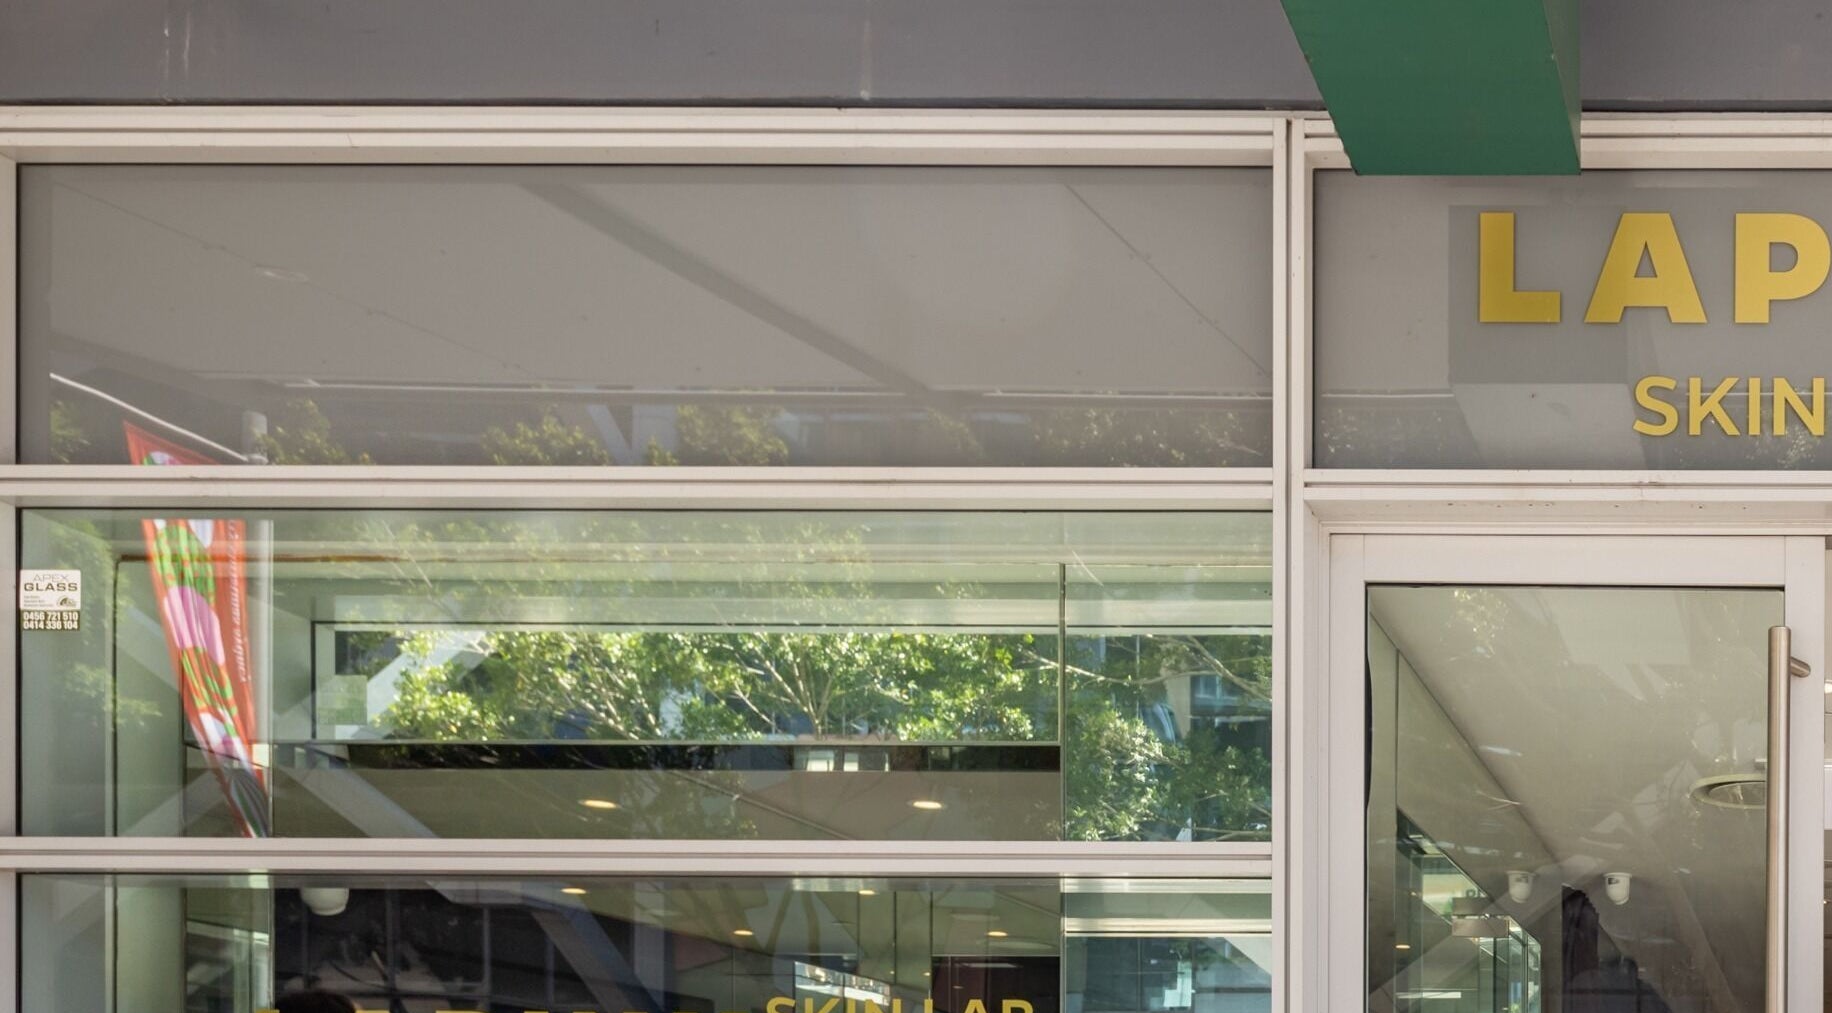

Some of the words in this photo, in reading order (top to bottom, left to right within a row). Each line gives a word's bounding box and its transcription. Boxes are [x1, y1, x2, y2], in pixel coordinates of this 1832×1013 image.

[1632, 375, 1826, 437] SKIN
[24, 582, 78, 592] GLASS
[23, 621, 45, 630] 0414
